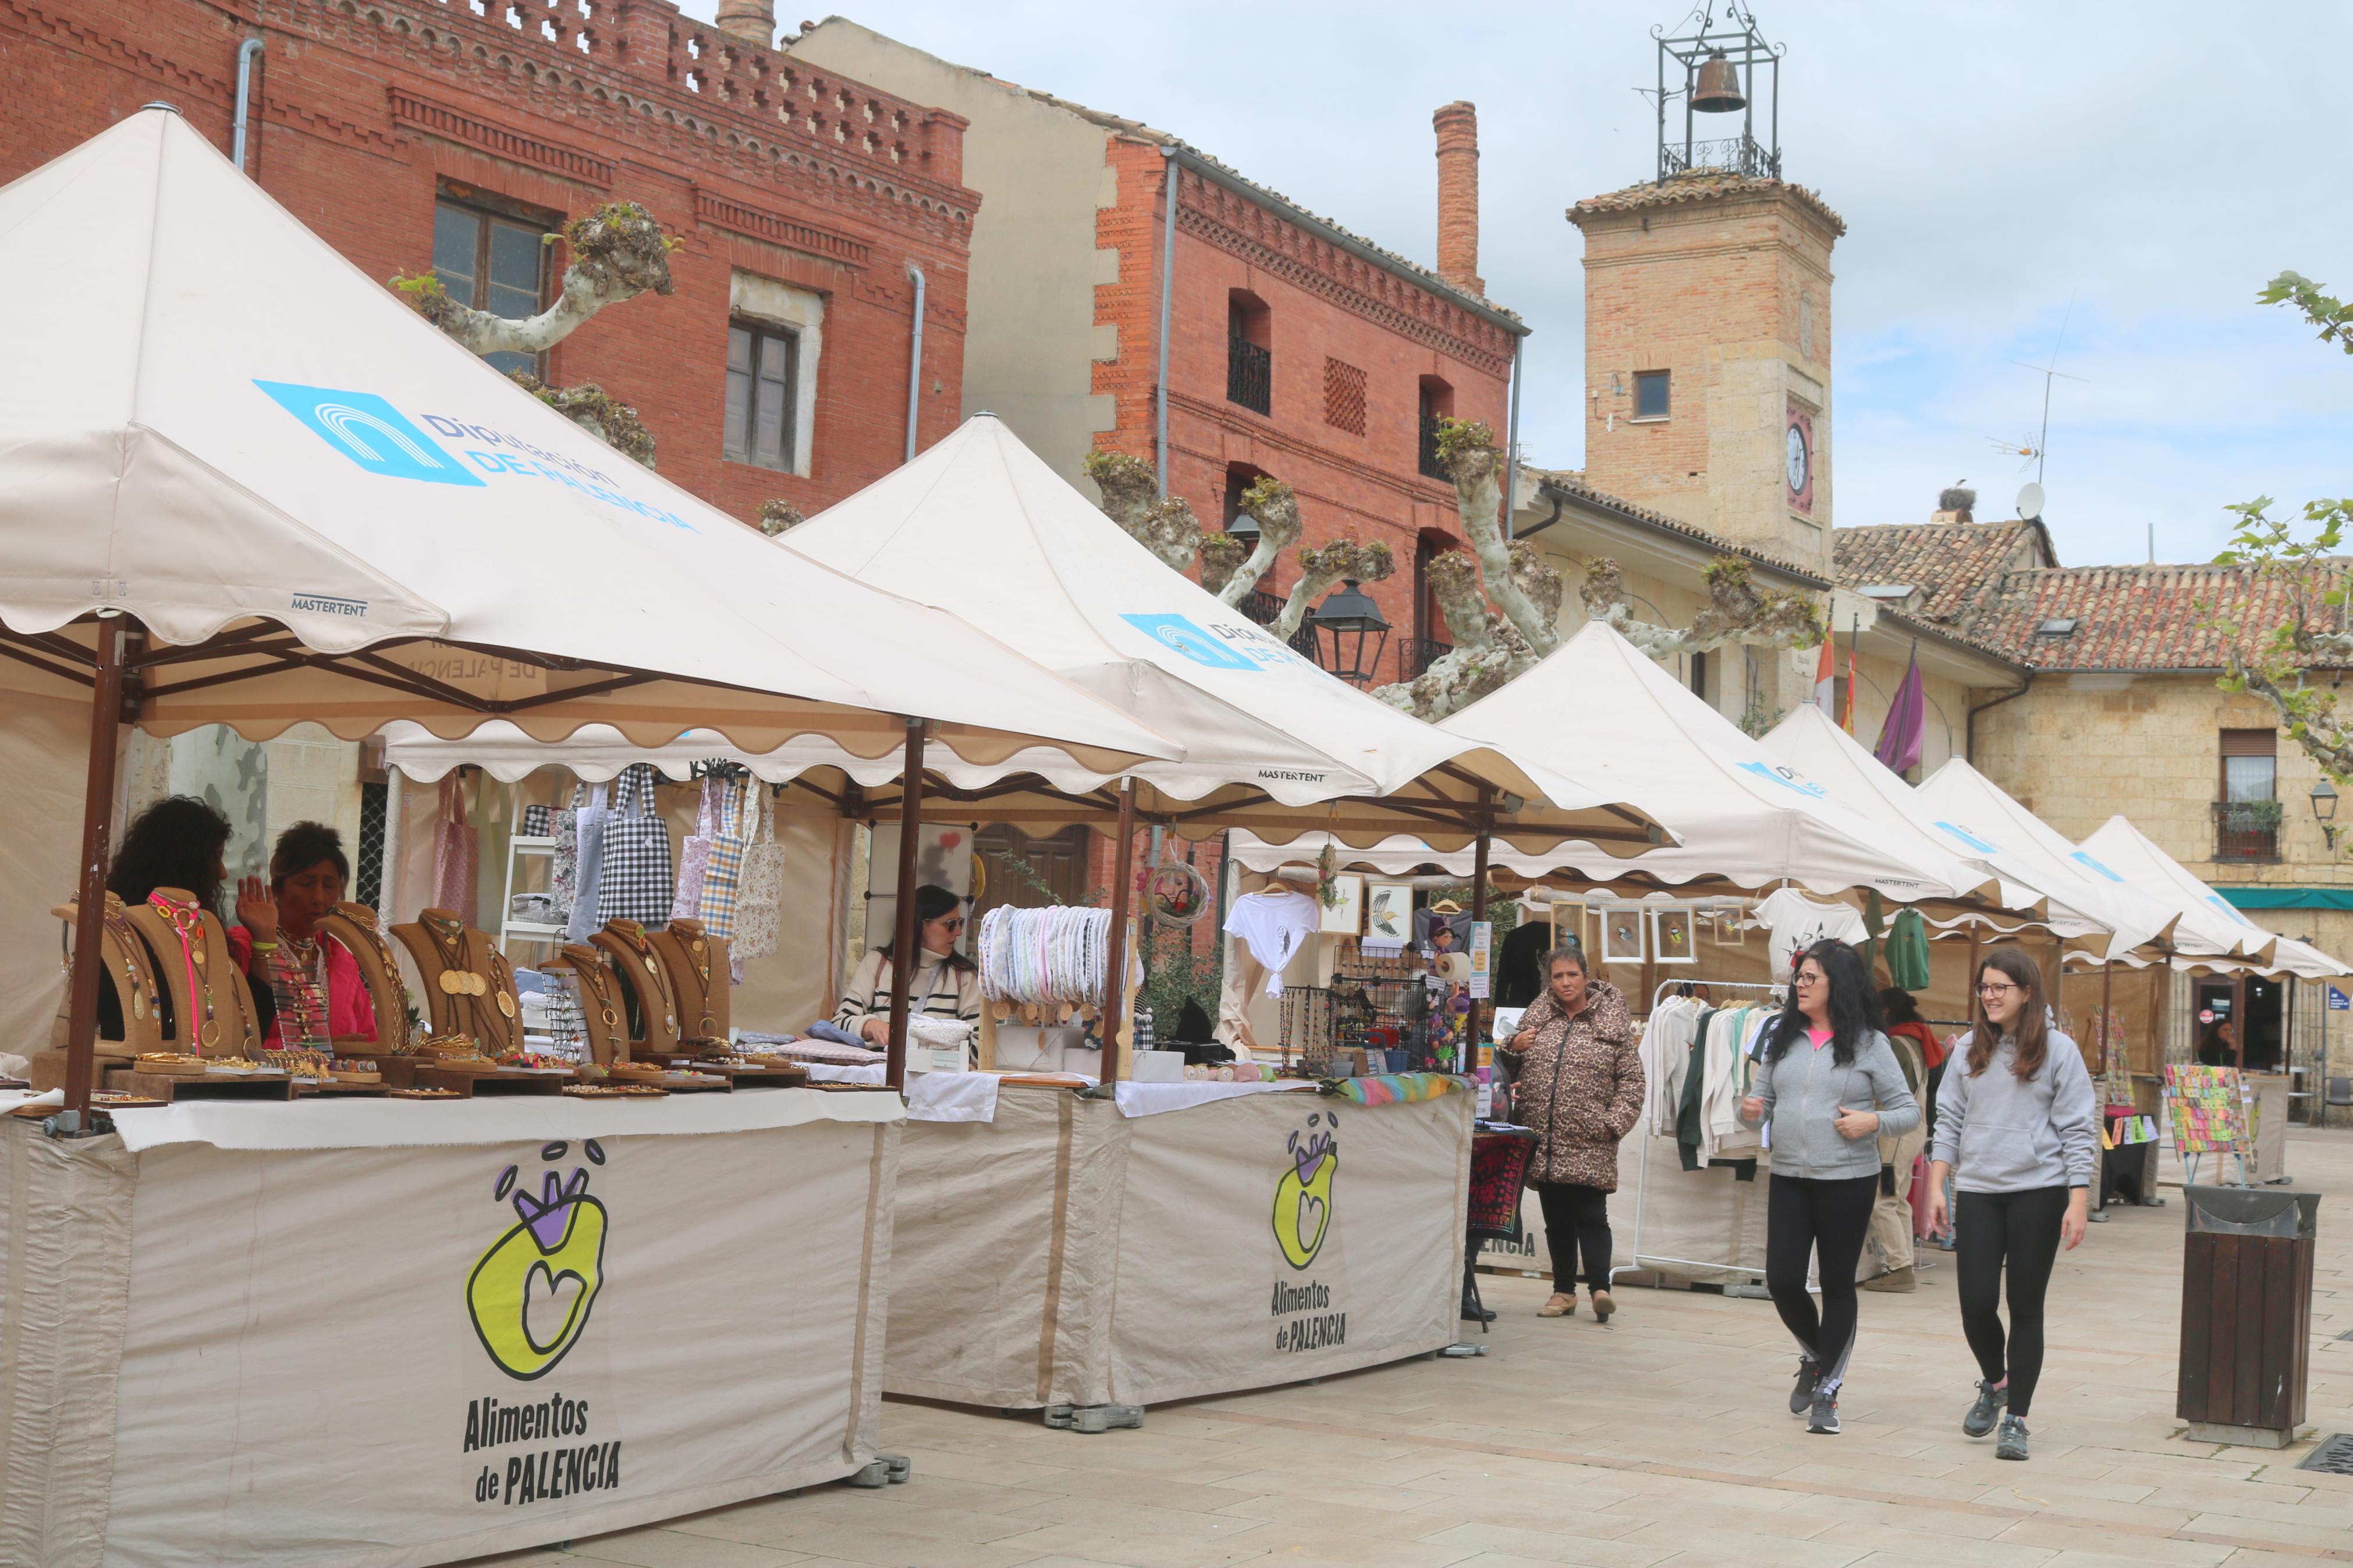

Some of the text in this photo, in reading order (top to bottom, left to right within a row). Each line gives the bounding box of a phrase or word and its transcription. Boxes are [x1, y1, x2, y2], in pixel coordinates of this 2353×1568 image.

[464, 450, 702, 535] DE PALENCIA
[292, 598, 367, 617] MASTERTENT
[1258, 769, 1325, 783] MASTERTENT
[1875, 878, 1921, 888] MASTERTENT
[1272, 1279, 1330, 1316] Alimentos
[1276, 1312, 1346, 1353] de PALENCIA
[464, 1392, 588, 1453] Alimentos
[475, 1441, 622, 1506] de PALENCIA
